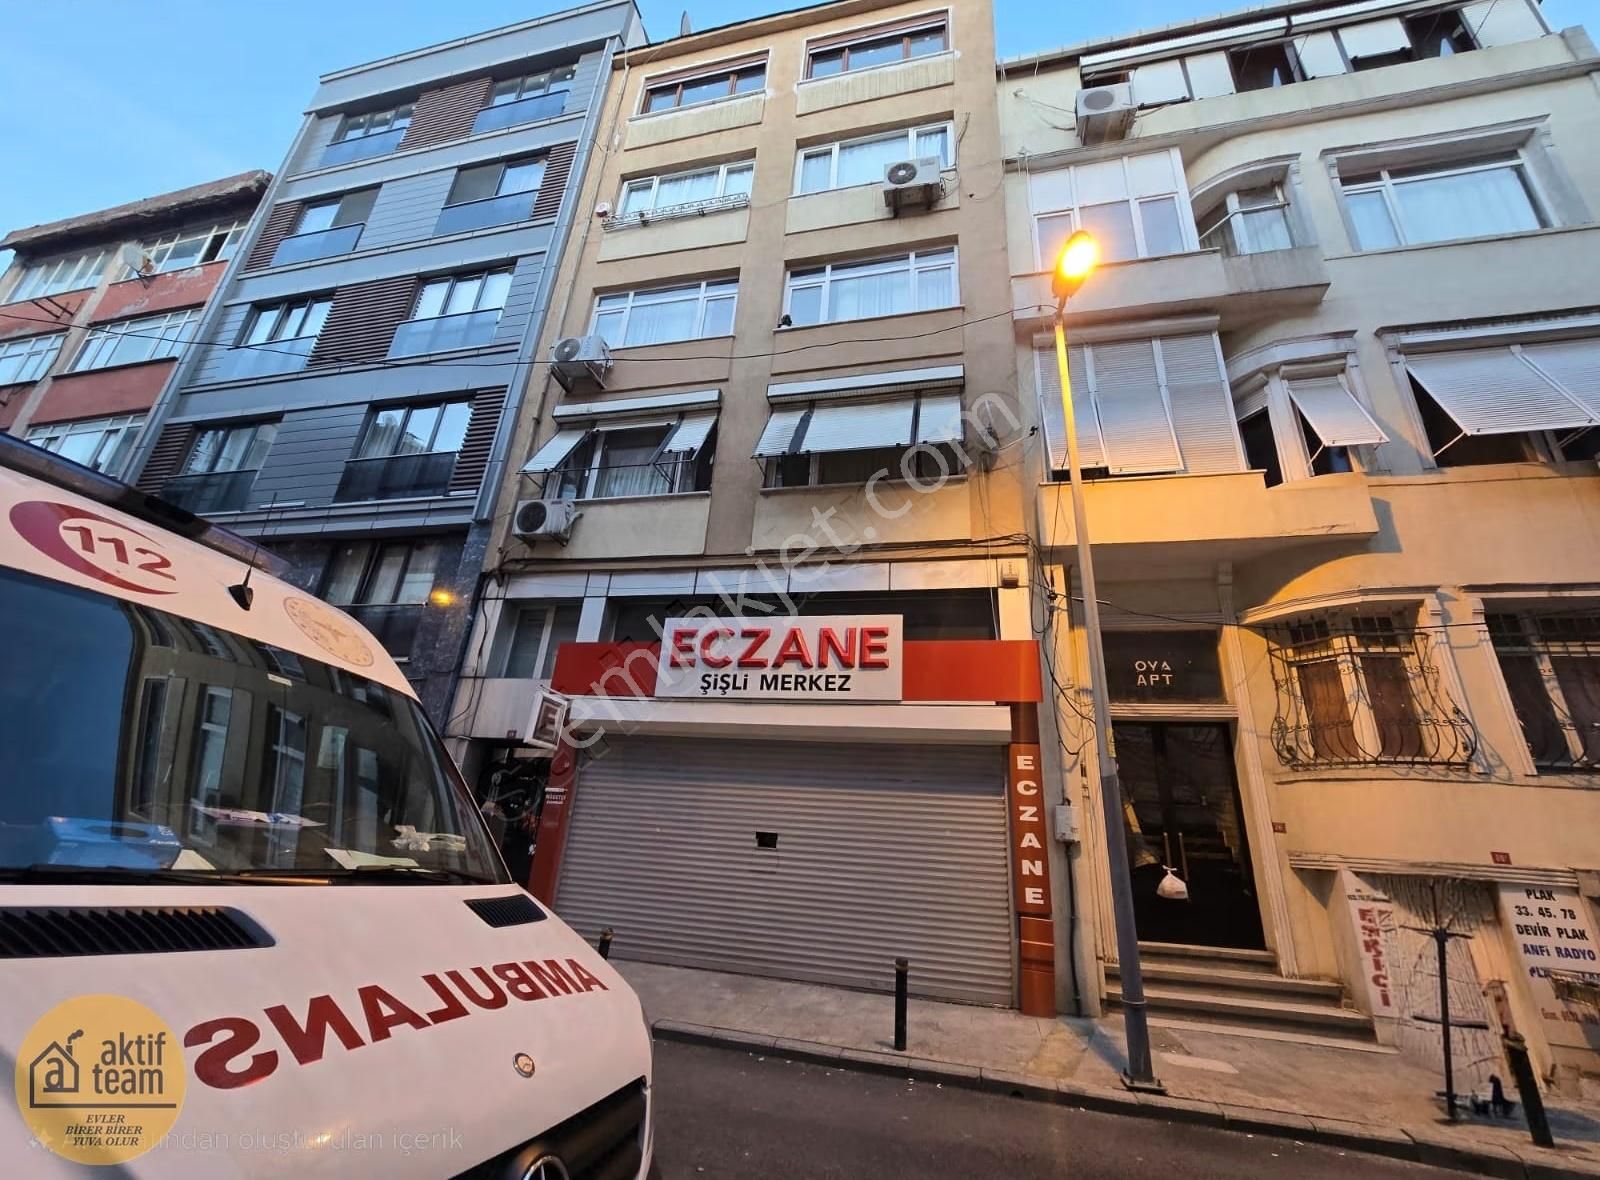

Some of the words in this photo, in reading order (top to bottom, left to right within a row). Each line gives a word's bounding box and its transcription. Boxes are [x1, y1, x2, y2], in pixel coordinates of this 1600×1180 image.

[62, 525, 176, 581] 112
[669, 627, 889, 669] ECZANE
[1135, 660, 1171, 671] OYA
[759, 674, 851, 692] MERKEZ
[1137, 674, 1173, 686] APT
[1016, 755, 1044, 904] ECZANE
[1525, 888, 1556, 901] PLAK
[1560, 908, 1576, 920] 78
[1556, 927, 1589, 941] PLAK
[1555, 946, 1597, 961] RADYO
